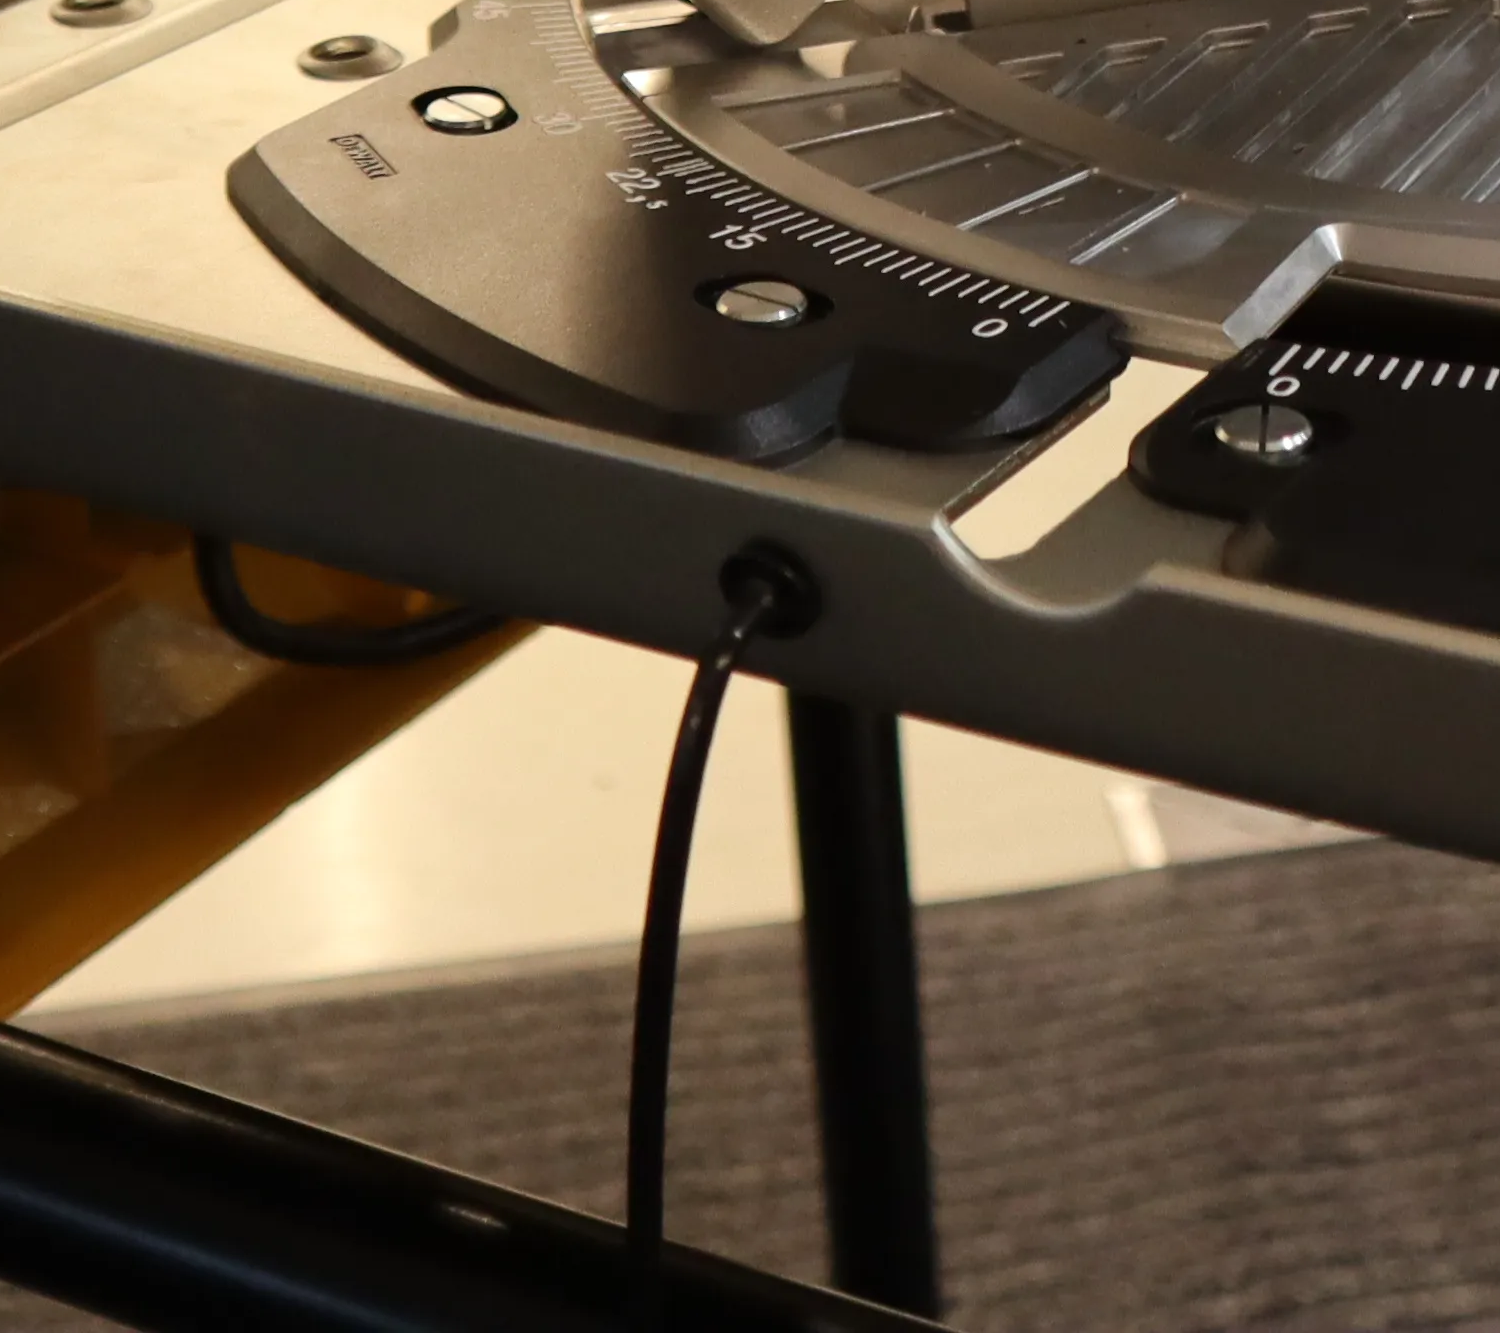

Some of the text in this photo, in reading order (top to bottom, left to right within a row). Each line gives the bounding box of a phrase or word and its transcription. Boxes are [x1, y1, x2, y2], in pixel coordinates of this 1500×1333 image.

[532, 111, 584, 135] 30
[708, 224, 768, 261] 15
[971, 318, 1009, 338] 0
[1266, 376, 1301, 397] 0
